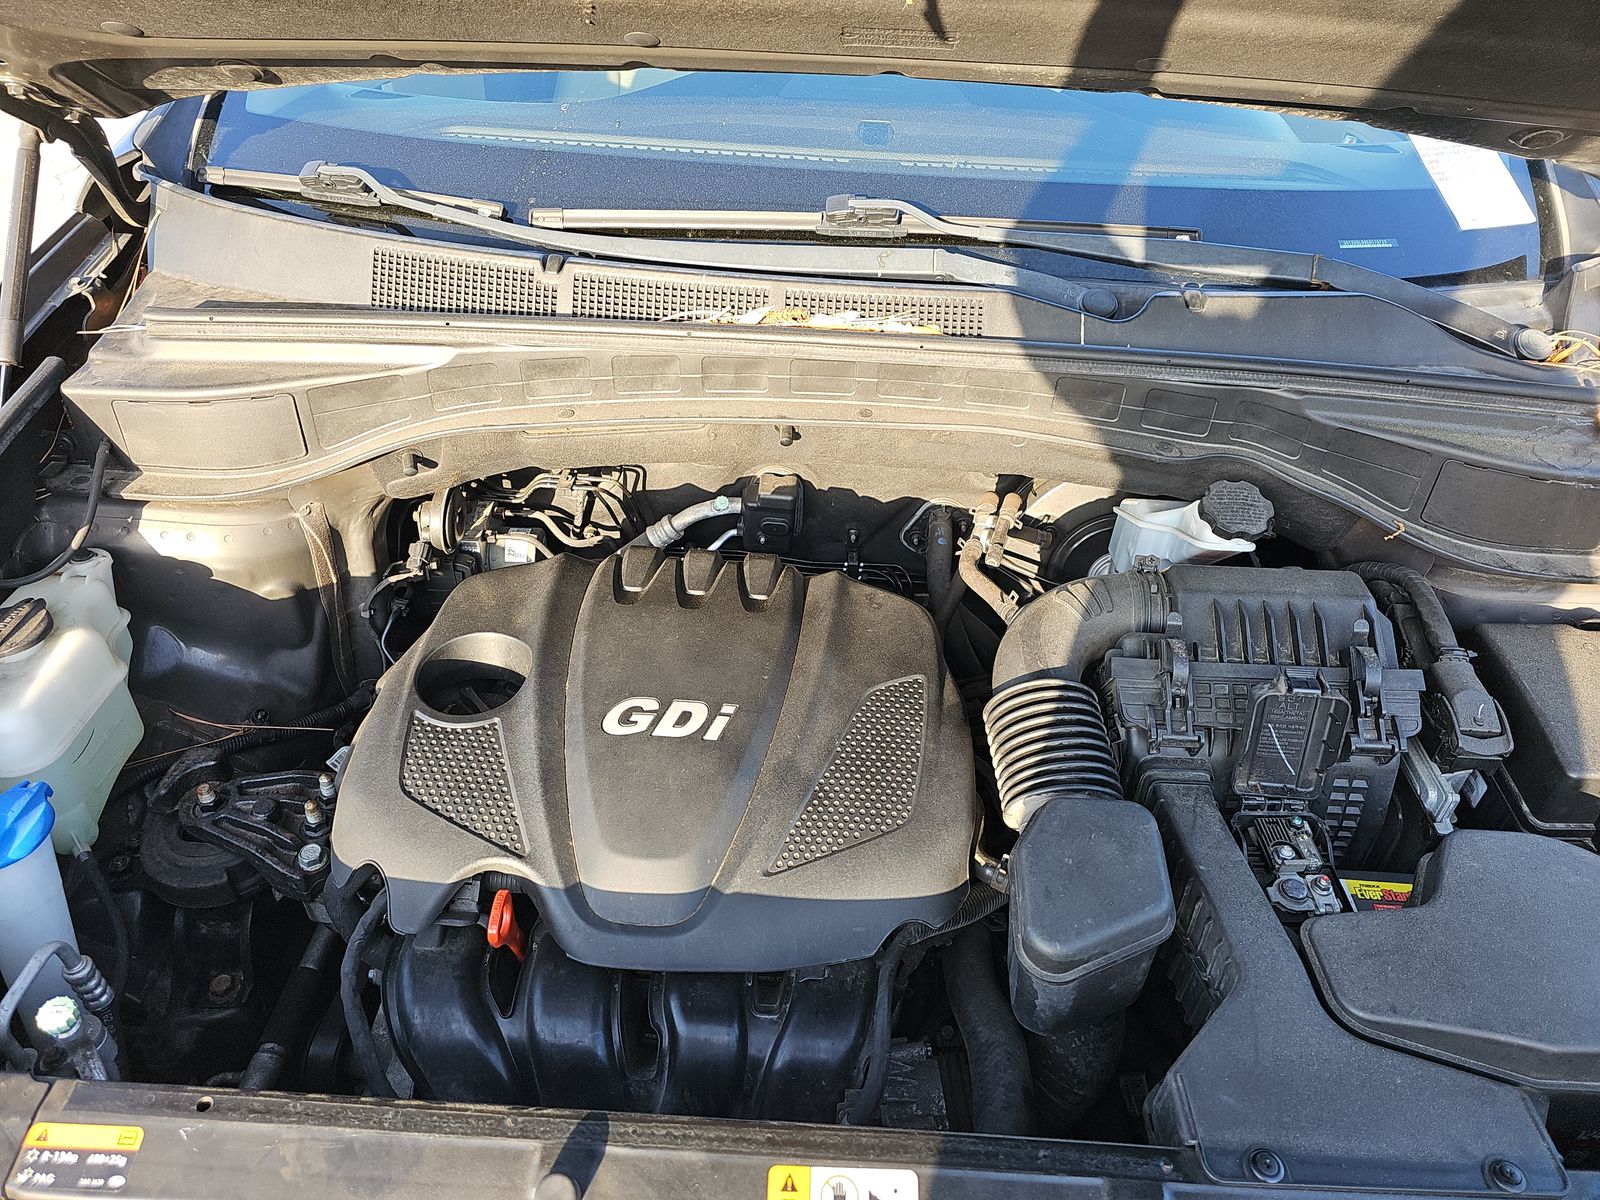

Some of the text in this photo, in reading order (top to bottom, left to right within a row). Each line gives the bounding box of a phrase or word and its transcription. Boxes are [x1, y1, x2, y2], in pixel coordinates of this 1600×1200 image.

[1279, 702, 1301, 710] ALT
[601, 696, 739, 741] GDi
[1355, 888, 1411, 902] EverStar
